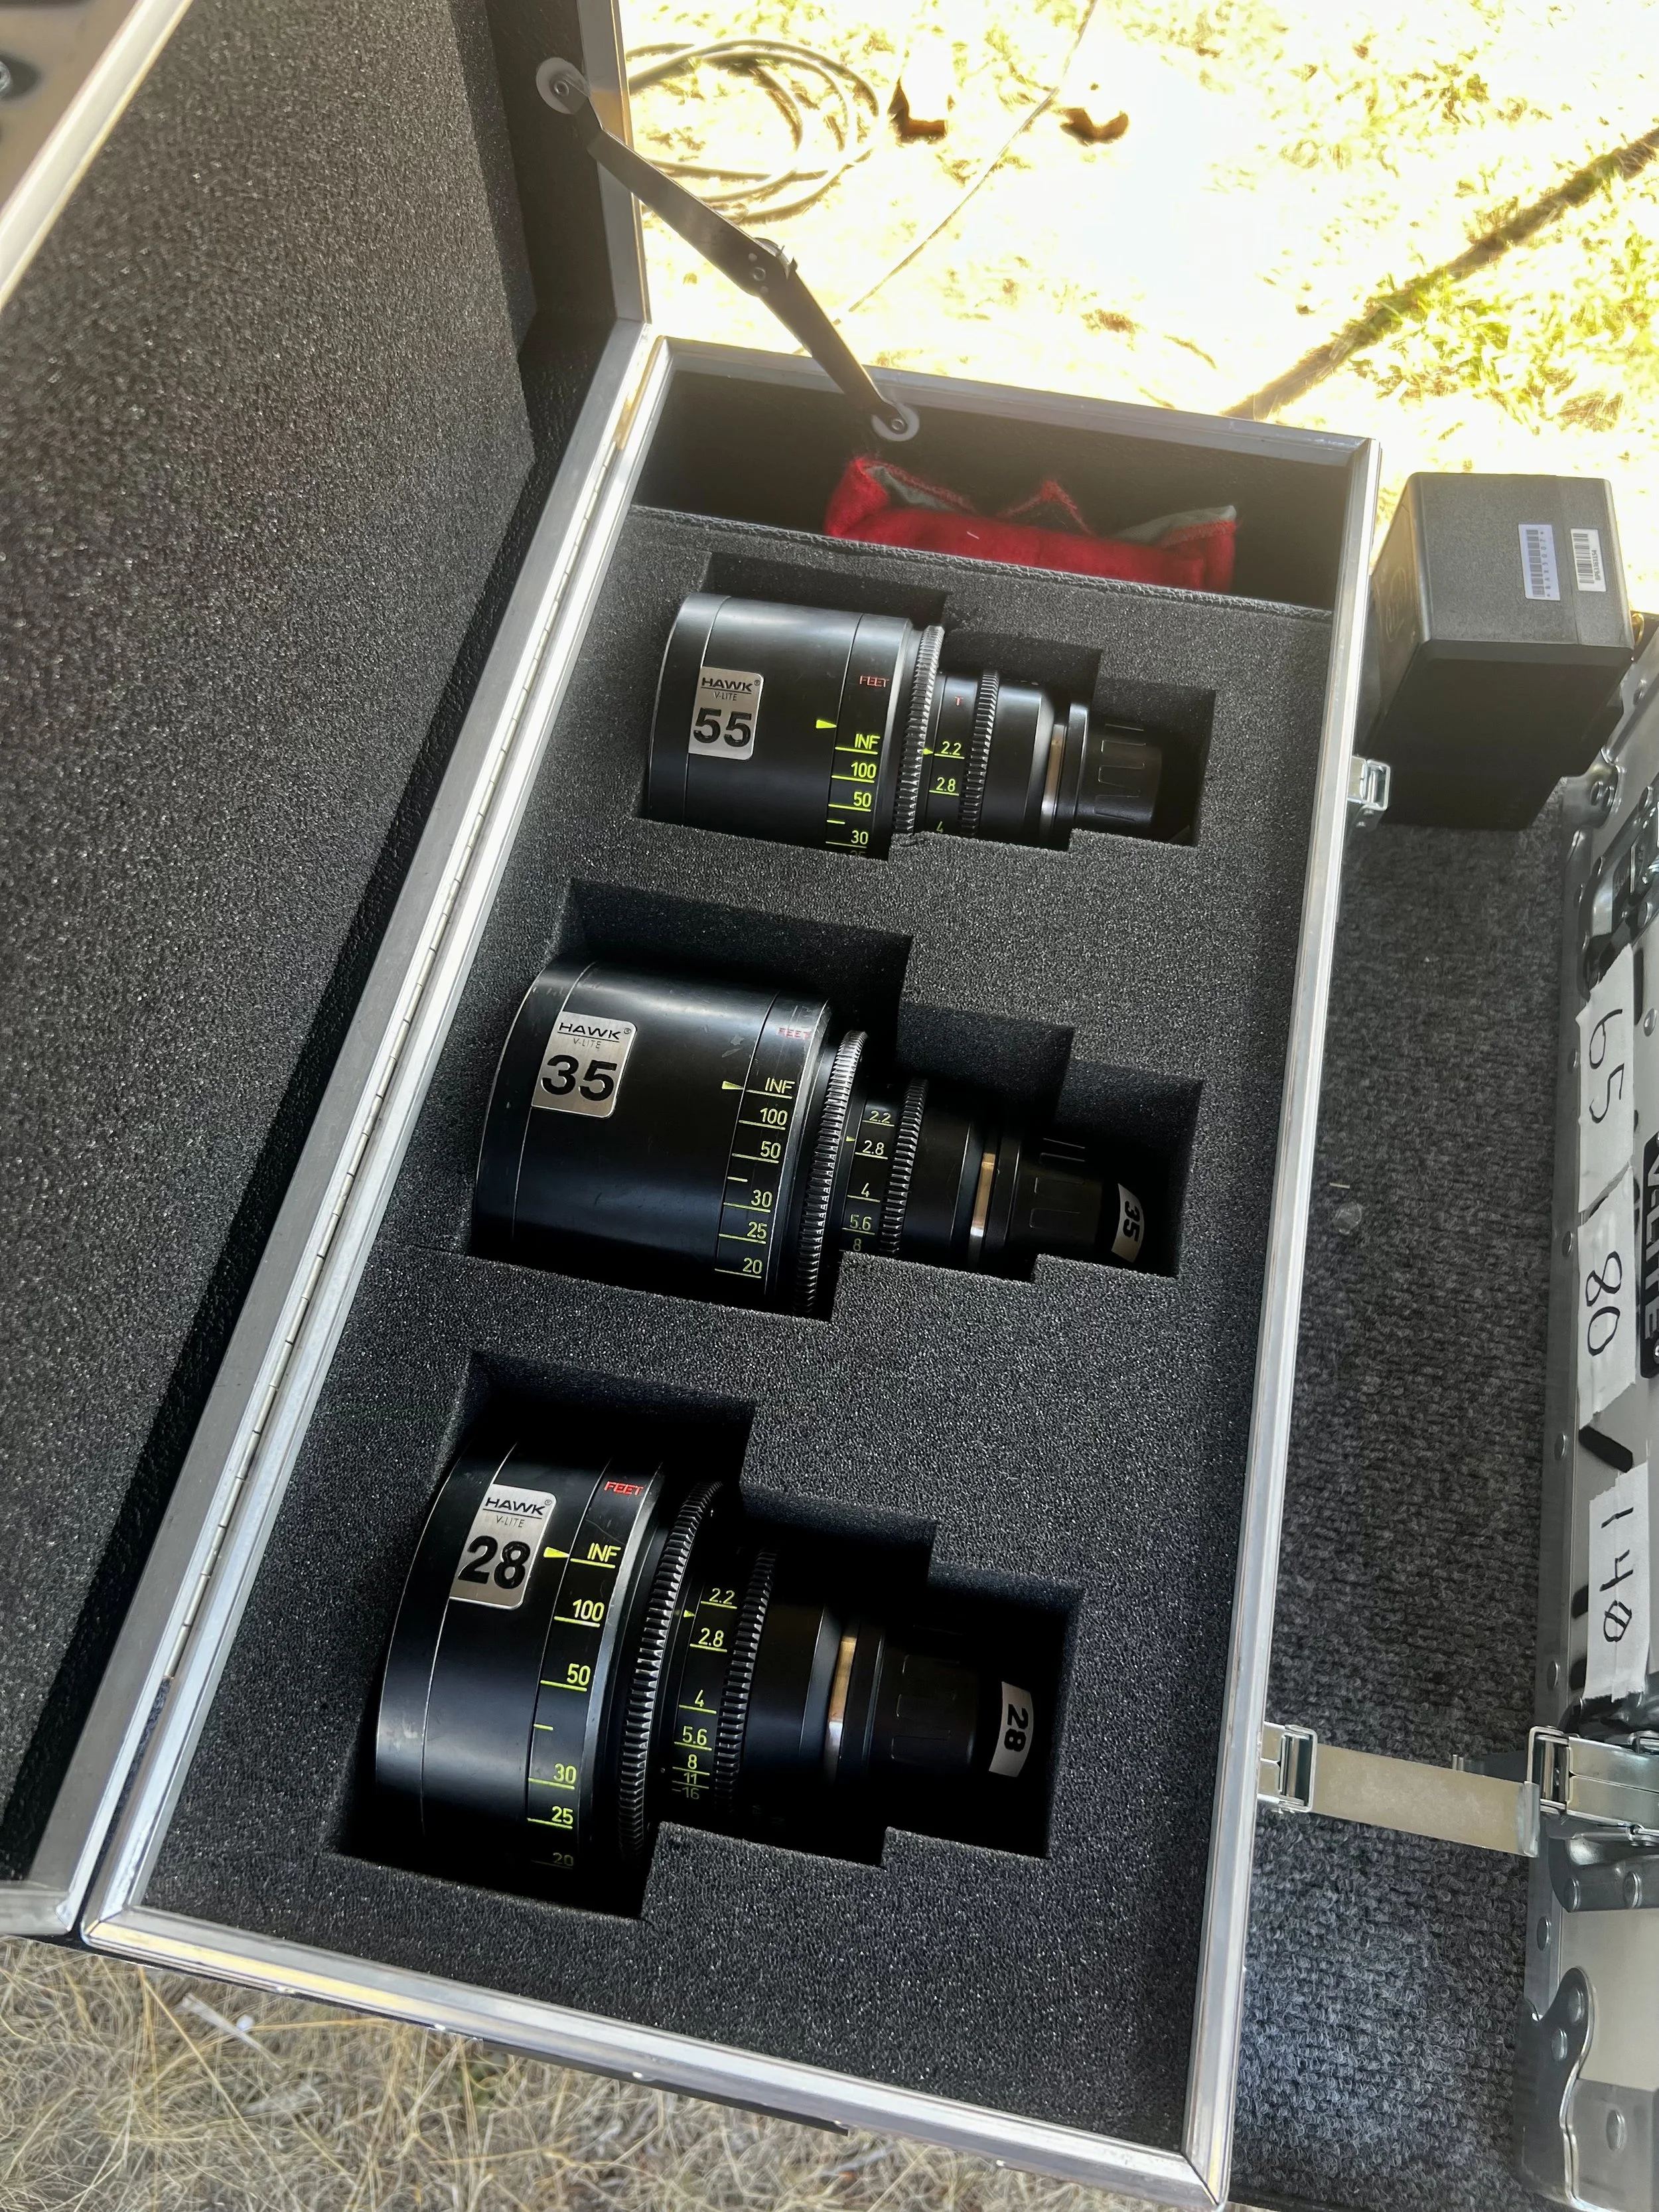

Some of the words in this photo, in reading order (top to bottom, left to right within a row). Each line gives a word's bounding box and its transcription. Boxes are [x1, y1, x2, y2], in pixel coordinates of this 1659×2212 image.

[859, 675, 890, 688] FEET
[714, 691, 737, 701] V-LITE
[954, 696, 964, 706] T
[693, 707, 752, 747] 55
[854, 733, 881, 749] INF
[941, 741, 962, 755] 2.2
[851, 762, 877, 779] 100
[936, 776, 956, 792] 2.8
[853, 791, 872, 808] 50
[936, 820, 944, 833] 4
[851, 830, 869, 845] 30
[777, 1027, 812, 1040] FEET
[573, 1037, 602, 1049] V-LITE
[1589, 1009, 1624, 1124] 65
[541, 1054, 618, 1102] 35
[764, 1077, 796, 1094] INF
[760, 1108, 788, 1126] 100
[869, 1110, 892, 1124] 2.2
[760, 1141, 782, 1159] 50
[861, 1139, 885, 1155] 2.8
[861, 1181, 870, 1197] 4
[751, 1189, 773, 1208] 30
[849, 1213, 872, 1232] 5.6
[1123, 1201, 1140, 1242] 35
[747, 1221, 768, 1240] 25
[852, 1236, 862, 1252] 8
[742, 1257, 763, 1274] 20
[1585, 1250, 1623, 1357] 80
[603, 1481, 644, 1496] FEET
[496, 1514, 526, 1528] V-LITE
[587, 1542, 622, 1563] INF
[458, 1534, 531, 1589] 28
[708, 1587, 736, 1605] 2.2
[572, 1598, 605, 1622] 100
[697, 1627, 725, 1648] 2.8
[567, 1662, 591, 1686] 50
[694, 1689, 705, 1708] 4
[682, 1725, 707, 1746] 5.6
[1003, 1703, 1029, 1752] 28
[687, 1753, 698, 1770] 8
[553, 1763, 577, 1785] 30
[683, 1771, 697, 1785] 11
[551, 1805, 574, 1824] 25
[552, 1852, 575, 1867] 20
